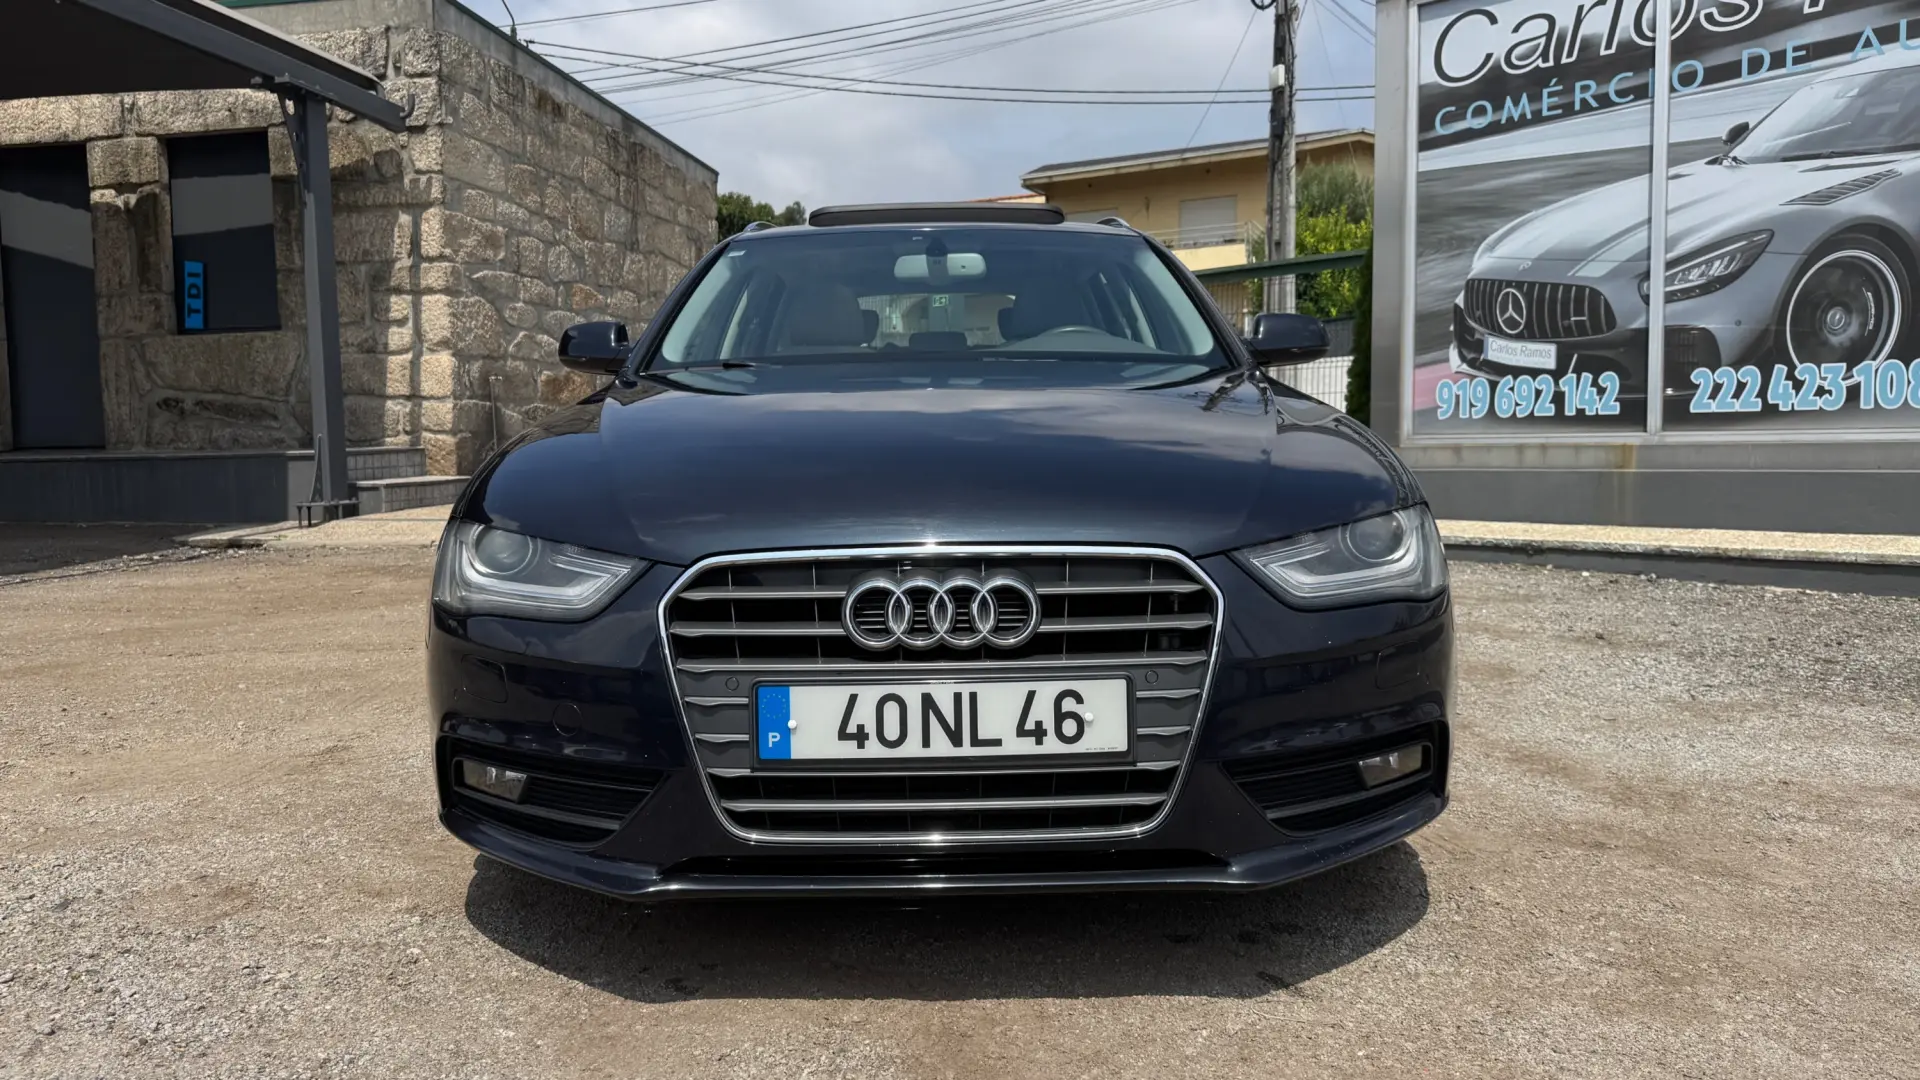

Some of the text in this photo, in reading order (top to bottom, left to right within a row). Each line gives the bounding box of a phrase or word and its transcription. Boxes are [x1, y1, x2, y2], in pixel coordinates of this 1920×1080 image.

[1435, 59, 1704, 135] COMÉRCIO
[1741, 40, 1812, 81] DE
[187, 272, 201, 318] TDI
[1490, 340, 1552, 359] Carlos Ramos
[1436, 371, 1621, 420] 919 692 142
[1689, 365, 1762, 413] 222
[1767, 362, 1847, 411] 423
[768, 732, 780, 748] P
